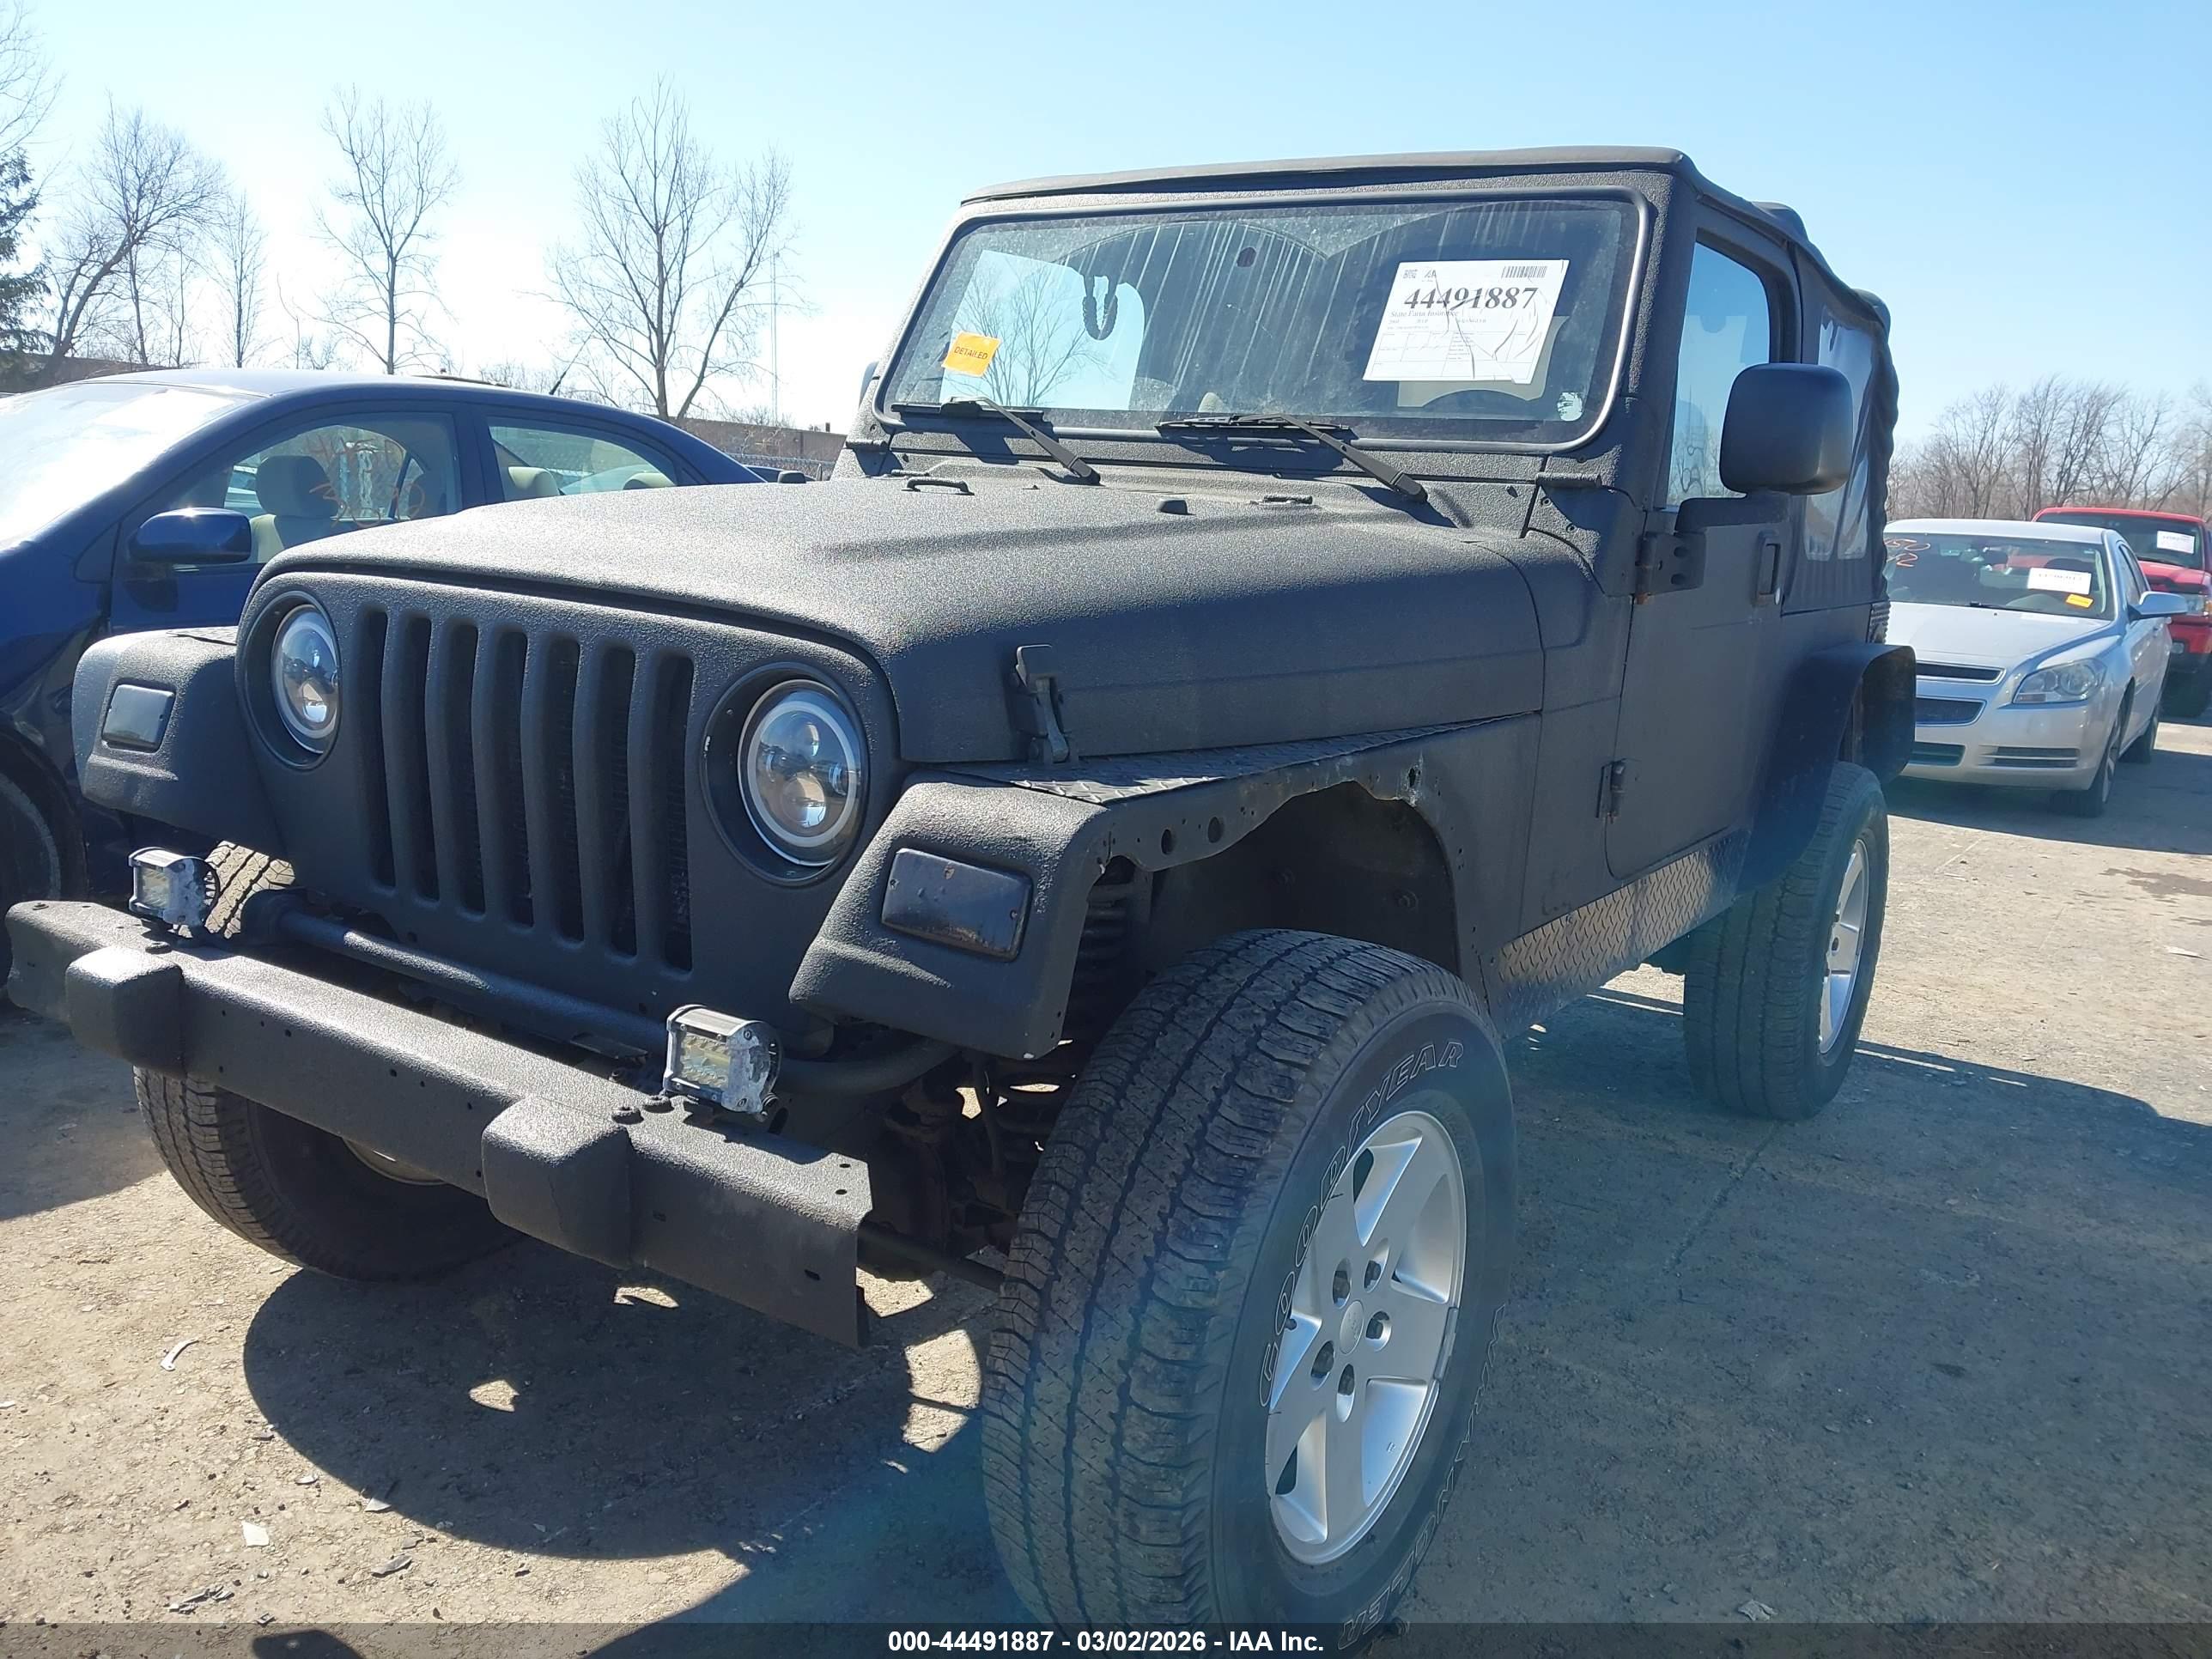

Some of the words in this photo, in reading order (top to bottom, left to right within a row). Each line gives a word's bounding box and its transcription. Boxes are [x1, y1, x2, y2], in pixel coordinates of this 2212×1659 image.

[1404, 287, 1538, 309] 44491887
[953, 346, 988, 360] DETAILED
[1259, 1042, 1464, 1408] GOODYEAR
